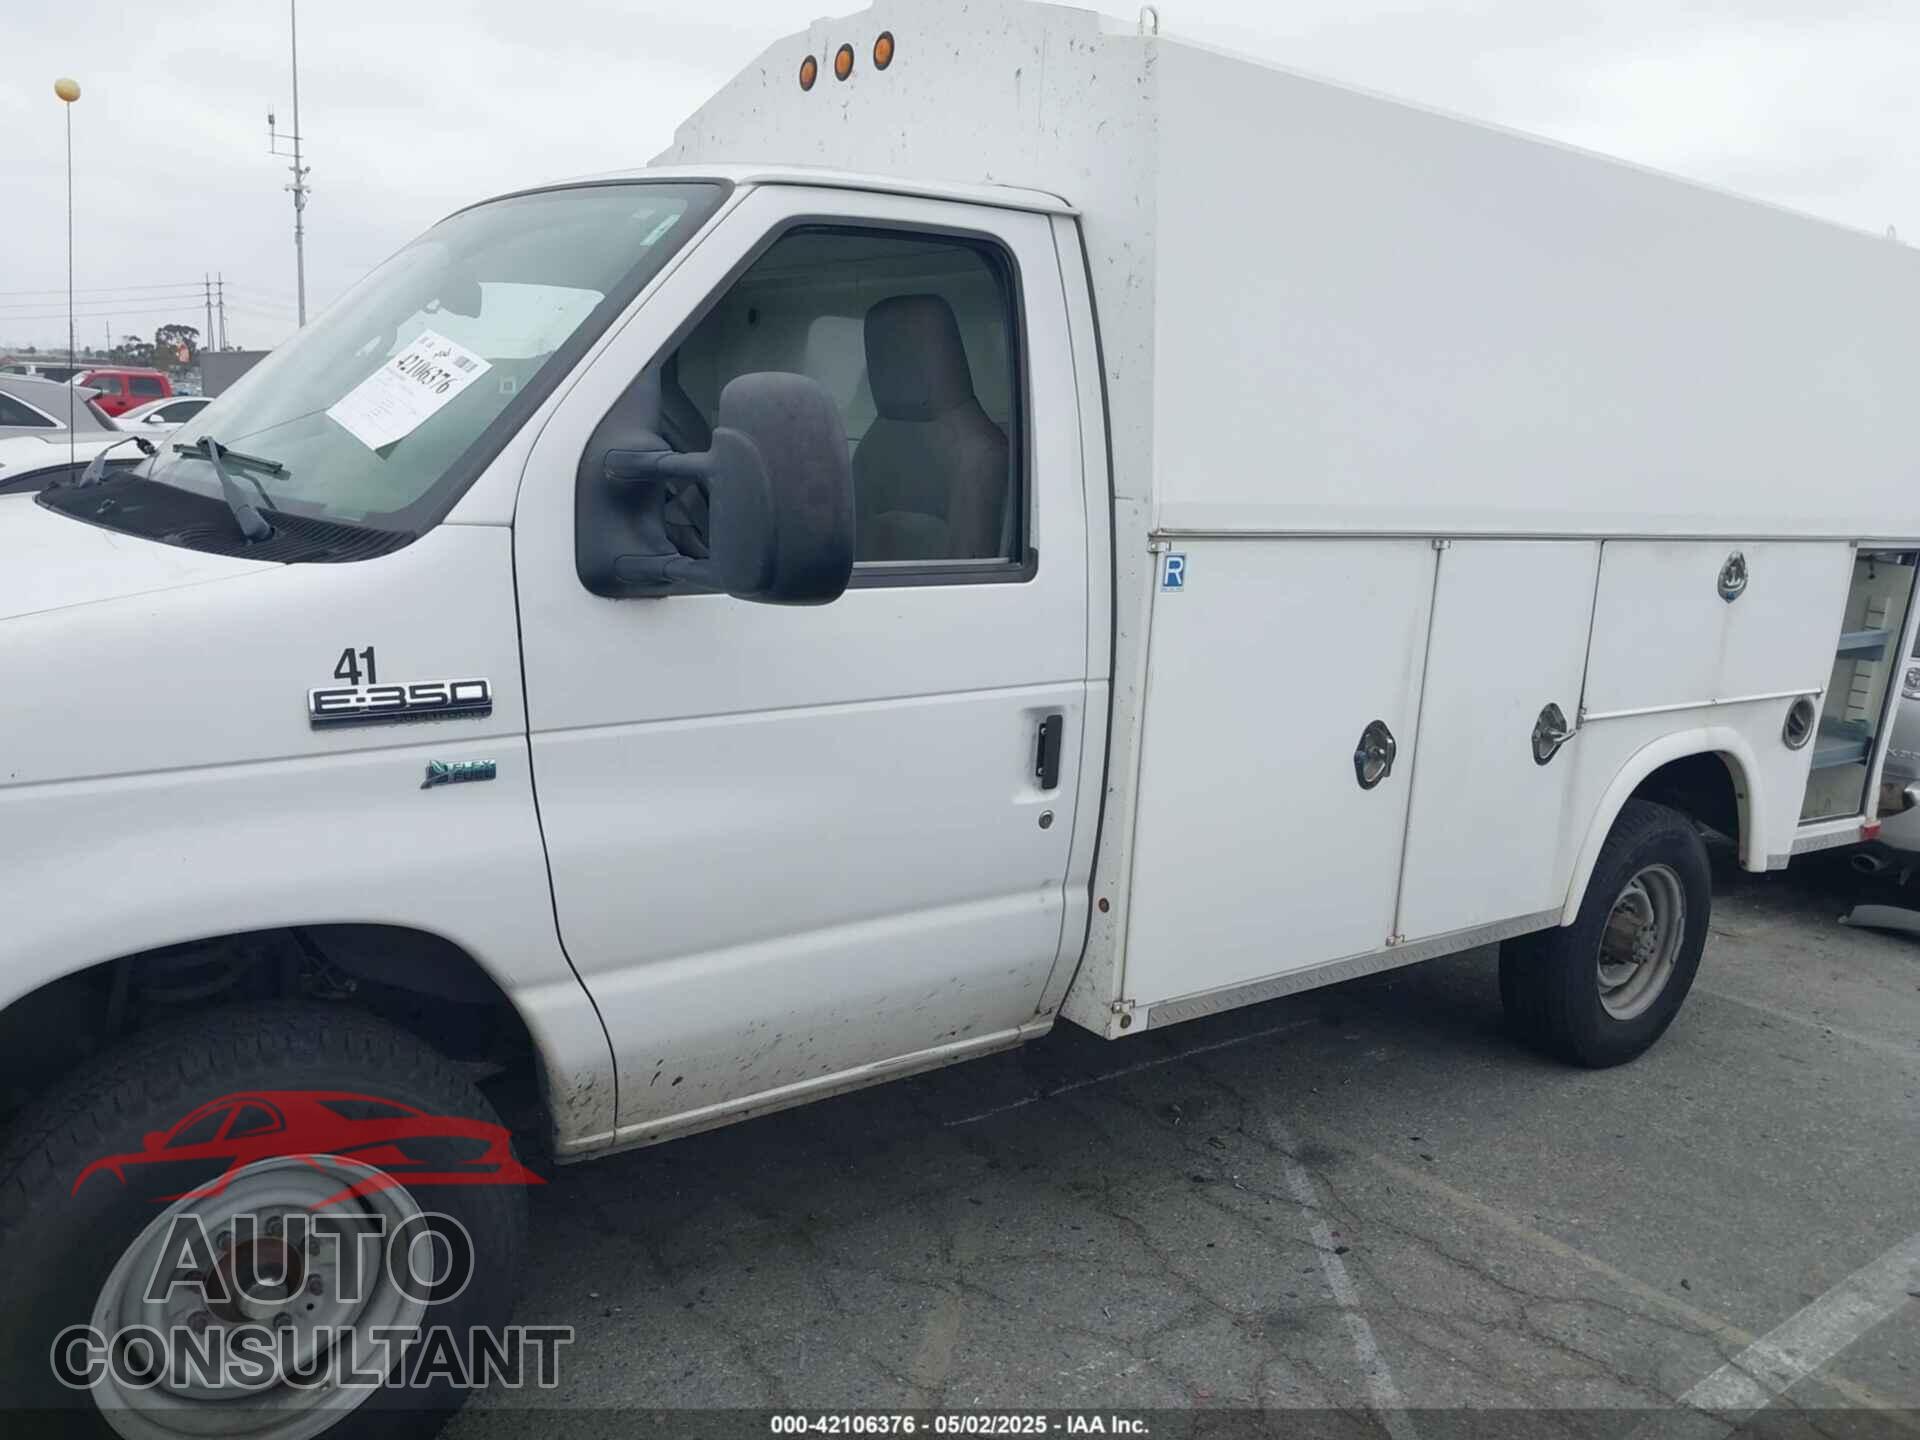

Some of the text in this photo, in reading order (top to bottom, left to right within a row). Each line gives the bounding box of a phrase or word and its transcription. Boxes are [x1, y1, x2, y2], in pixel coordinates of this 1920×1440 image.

[397, 353, 457, 394] 42106376
[1164, 556, 1184, 585] R
[333, 645, 377, 686] 41
[312, 679, 489, 715] E-350
